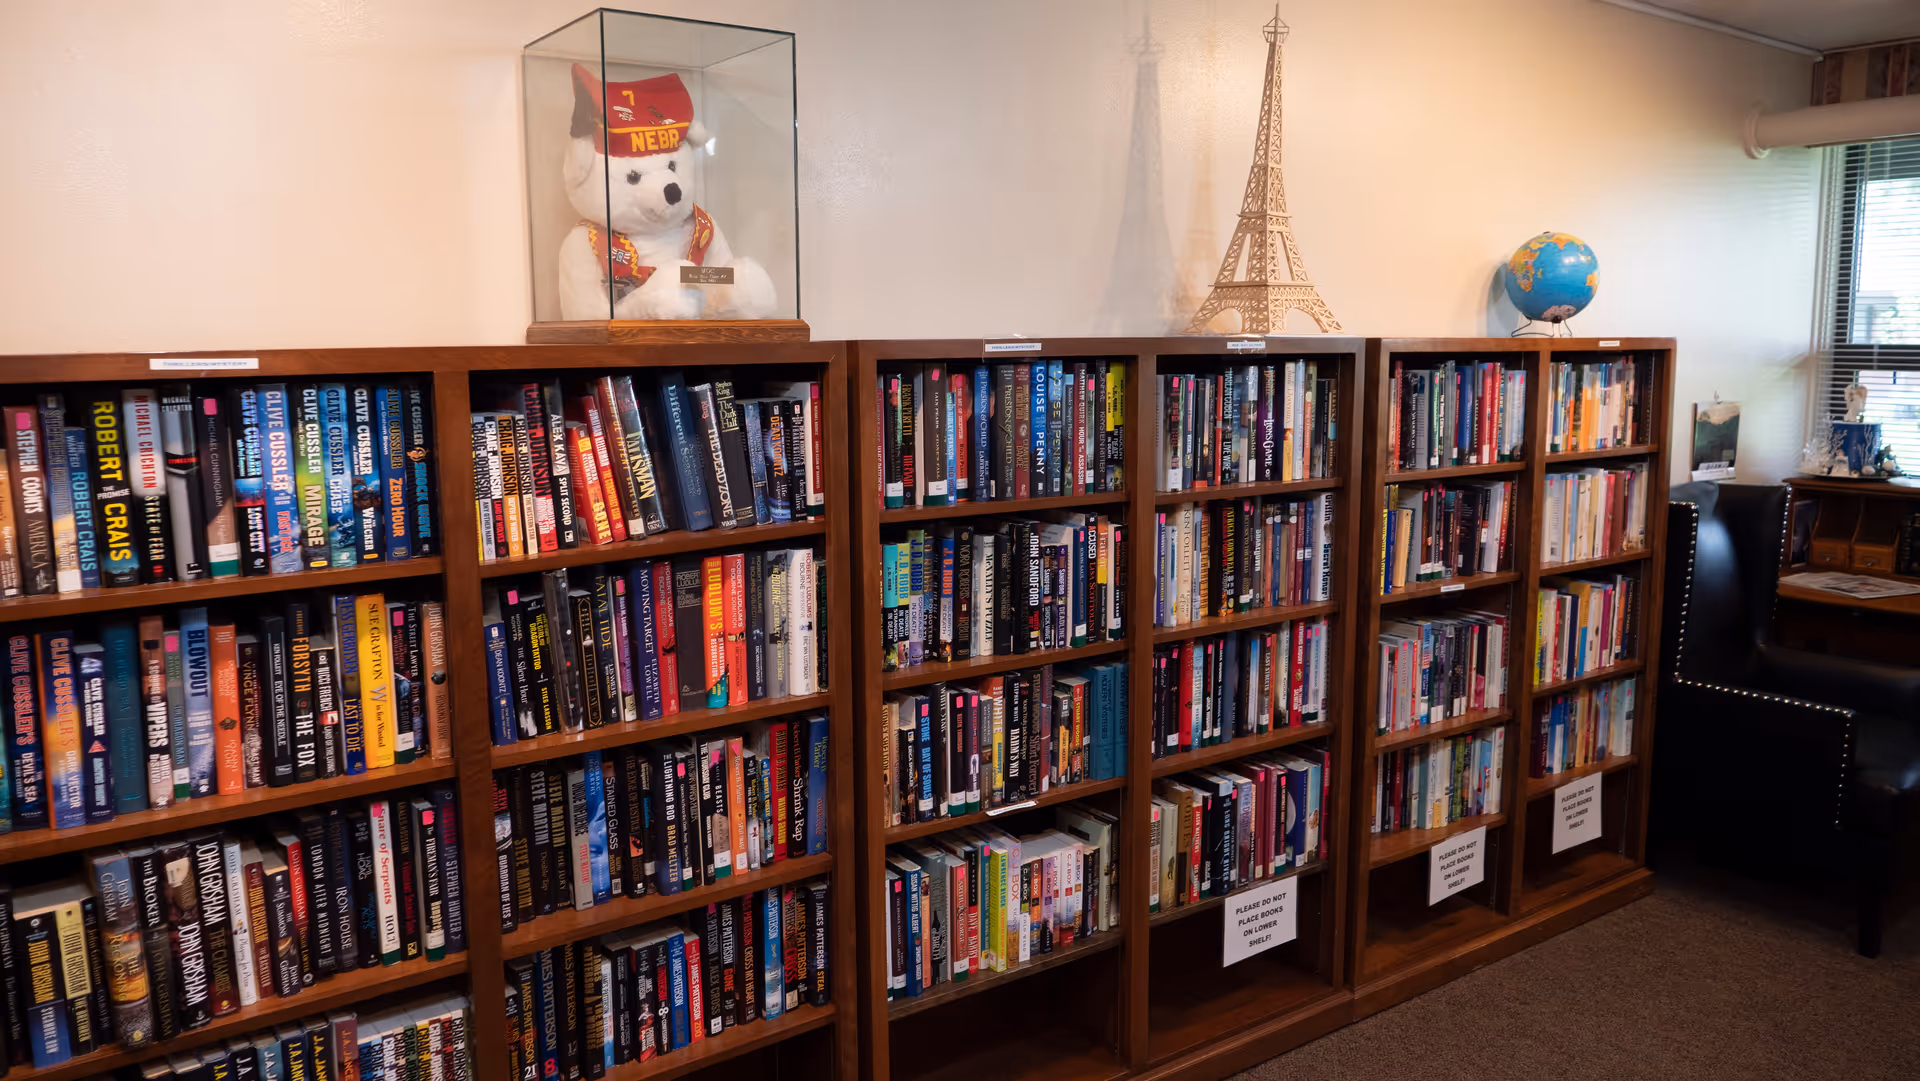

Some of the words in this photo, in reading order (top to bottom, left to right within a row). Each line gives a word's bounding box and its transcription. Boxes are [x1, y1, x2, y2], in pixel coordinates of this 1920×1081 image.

[621, 90, 635, 106] 7
[303, 389, 317, 421] CLIVE
[326, 390, 341, 422] CLIVE
[354, 388, 369, 422] CLIVE
[1036, 367, 1044, 413] LOUISE
[1053, 370, 1061, 418] LOUISE
[134, 395, 151, 438] MICHAEL
[265, 391, 284, 428] CLIVE
[93, 402, 123, 482] ROBERT
[485, 421, 498, 450] CRAIG
[498, 419, 512, 448] CRAIG
[516, 419, 527, 448] CRAIG
[551, 414, 564, 442] ALEX
[708, 428, 719, 451] THE
[770, 416, 780, 440] DEAN
[16, 429, 40, 472] STEPHEN
[269, 432, 289, 491] CUSSLER
[305, 423, 322, 473] CUSSLER
[329, 427, 344, 475] CUSSLER
[357, 425, 373, 475] CUSSLER
[554, 444, 568, 473] KAVA
[772, 442, 783, 477] KOONTZ
[1036, 432, 1045, 474] PENNY
[1052, 430, 1060, 473] PENNY
[1222, 455, 1231, 471] WIRE
[1223, 442, 1232, 455] LIVE
[138, 441, 158, 489] CRICHTON
[487, 452, 502, 499] JOHNSON
[502, 450, 517, 496] JOHNSON
[519, 449, 532, 495] JOHNSON
[712, 454, 725, 483] DEAD
[21, 477, 44, 514] COONTS
[97, 488, 130, 500] PROMISE
[329, 479, 344, 514] CHASE
[389, 478, 403, 505] ZERO
[414, 462, 427, 501] SHOCK
[559, 478, 568, 495] SPLIT
[72, 472, 92, 527] ROBERT
[304, 485, 324, 546] MIRAGE
[561, 497, 572, 525] SECOND
[716, 484, 733, 517] ZONE
[104, 503, 132, 561] CRAIS
[391, 507, 405, 537] HOUR
[417, 504, 431, 538] WAVE
[592, 502, 612, 539] GONE
[28, 519, 48, 569] AMERICA
[77, 530, 96, 571] CRAIS
[1029, 533, 1039, 557] JOHN
[1088, 526, 1096, 559] ACCUSED
[1322, 544, 1332, 570] Secret
[640, 570, 651, 614] MOVING
[1030, 559, 1039, 606] SANDFORD
[1321, 572, 1330, 596] Honor
[368, 603, 379, 625] SUE
[408, 607, 417, 622] THE
[708, 568, 722, 630] LUDLUM'S
[428, 607, 440, 629] JOHN
[644, 614, 654, 654] TARGET
[408, 624, 418, 648] STREET
[429, 631, 444, 667] GRISHAM
[8, 635, 28, 674] CLIVE
[187, 630, 208, 698] BLOWOUT
[292, 637, 311, 692] FORSYTH
[370, 627, 383, 680] GRAFTON
[410, 650, 419, 677] LAWYER
[494, 650, 504, 667] DEAN
[497, 668, 506, 693] KOONTZ
[644, 664, 652, 700] LOWELL
[651, 658, 660, 703] ELIZABETH
[12, 676, 35, 745] CUSSLER'S
[146, 702, 168, 747] VIPERS
[296, 712, 313, 737] THE
[344, 699, 358, 720] LAST
[993, 696, 1003, 733] WHITE
[346, 721, 358, 736] TO
[920, 717, 930, 742] STONE
[1010, 728, 1020, 760] HARM'S
[297, 743, 315, 767] FOX
[346, 738, 360, 752] DIE
[921, 747, 931, 763] BAY
[923, 764, 931, 774] OF
[1010, 761, 1019, 778] WAY
[530, 771, 547, 801] STEVE
[548, 775, 563, 803] STEVE
[605, 776, 616, 816] STAINED
[715, 785, 723, 813] BEASTS
[792, 777, 804, 817] Shrink
[923, 775, 932, 799] SOULS
[1561, 792, 1577, 803] PLEASE
[1585, 786, 1594, 794] NOT
[1563, 803, 1576, 812] PLACE
[1577, 797, 1592, 808] BOOKS
[1566, 814, 1572, 822] ON
[1573, 808, 1588, 818] LOWER
[533, 803, 550, 846] MARTINI
[551, 806, 566, 848] MARTINI
[609, 819, 618, 850] GLASS
[667, 824, 676, 846] BRAD
[792, 818, 804, 841] Rap
[1569, 820, 1584, 830] SHELF!
[196, 842, 222, 873] JOHN
[514, 838, 529, 867] STEVE
[668, 848, 678, 882] MELTZER
[1439, 849, 1457, 862] PLEASE
[1458, 845, 1465, 853] DO
[1467, 840, 1477, 851] NOT
[1440, 861, 1456, 872] PLACE
[1457, 852, 1474, 864] BOOKS
[143, 859, 152, 876] THE
[445, 861, 459, 898] STEPHEN
[1444, 872, 1452, 880] ON
[1452, 865, 1470, 878] LOWER
[100, 872, 116, 922] GRISHAM
[199, 873, 226, 926] GRISHAM
[335, 886, 349, 913] IRON
[517, 868, 533, 909] MARTINI
[1011, 874, 1019, 901] BOX
[1448, 878, 1465, 890] SHELF!
[142, 876, 161, 928] BROKER
[448, 900, 461, 934] HUNTER
[796, 902, 806, 931] JAMES
[815, 902, 824, 926] JAMES
[1236, 901, 1260, 915] PLEASE
[1262, 898, 1271, 906] DO
[1273, 893, 1286, 902] NOT
[1238, 914, 1259, 926] PLACE
[1261, 906, 1283, 918] BOOKS
[275, 902, 287, 937] SUMMONS
[339, 915, 352, 950] HOUSE
[1244, 928, 1253, 936] ON
[1255, 920, 1277, 933] LOWER
[63, 932, 82, 956] JOHN
[177, 921, 204, 952] JOHN
[816, 928, 824, 969] PATTERSON
[1249, 934, 1271, 947] SHELF!
[797, 931, 807, 980] PATTERSON
[66, 957, 88, 994] GRISHAM
[180, 952, 208, 1006] GRISHAM
[279, 960, 290, 995] GRISHAM
[521, 982, 531, 1011] JAMES
[566, 972, 577, 1031] PATTERSON
[523, 1011, 535, 1064] PATTERSON
